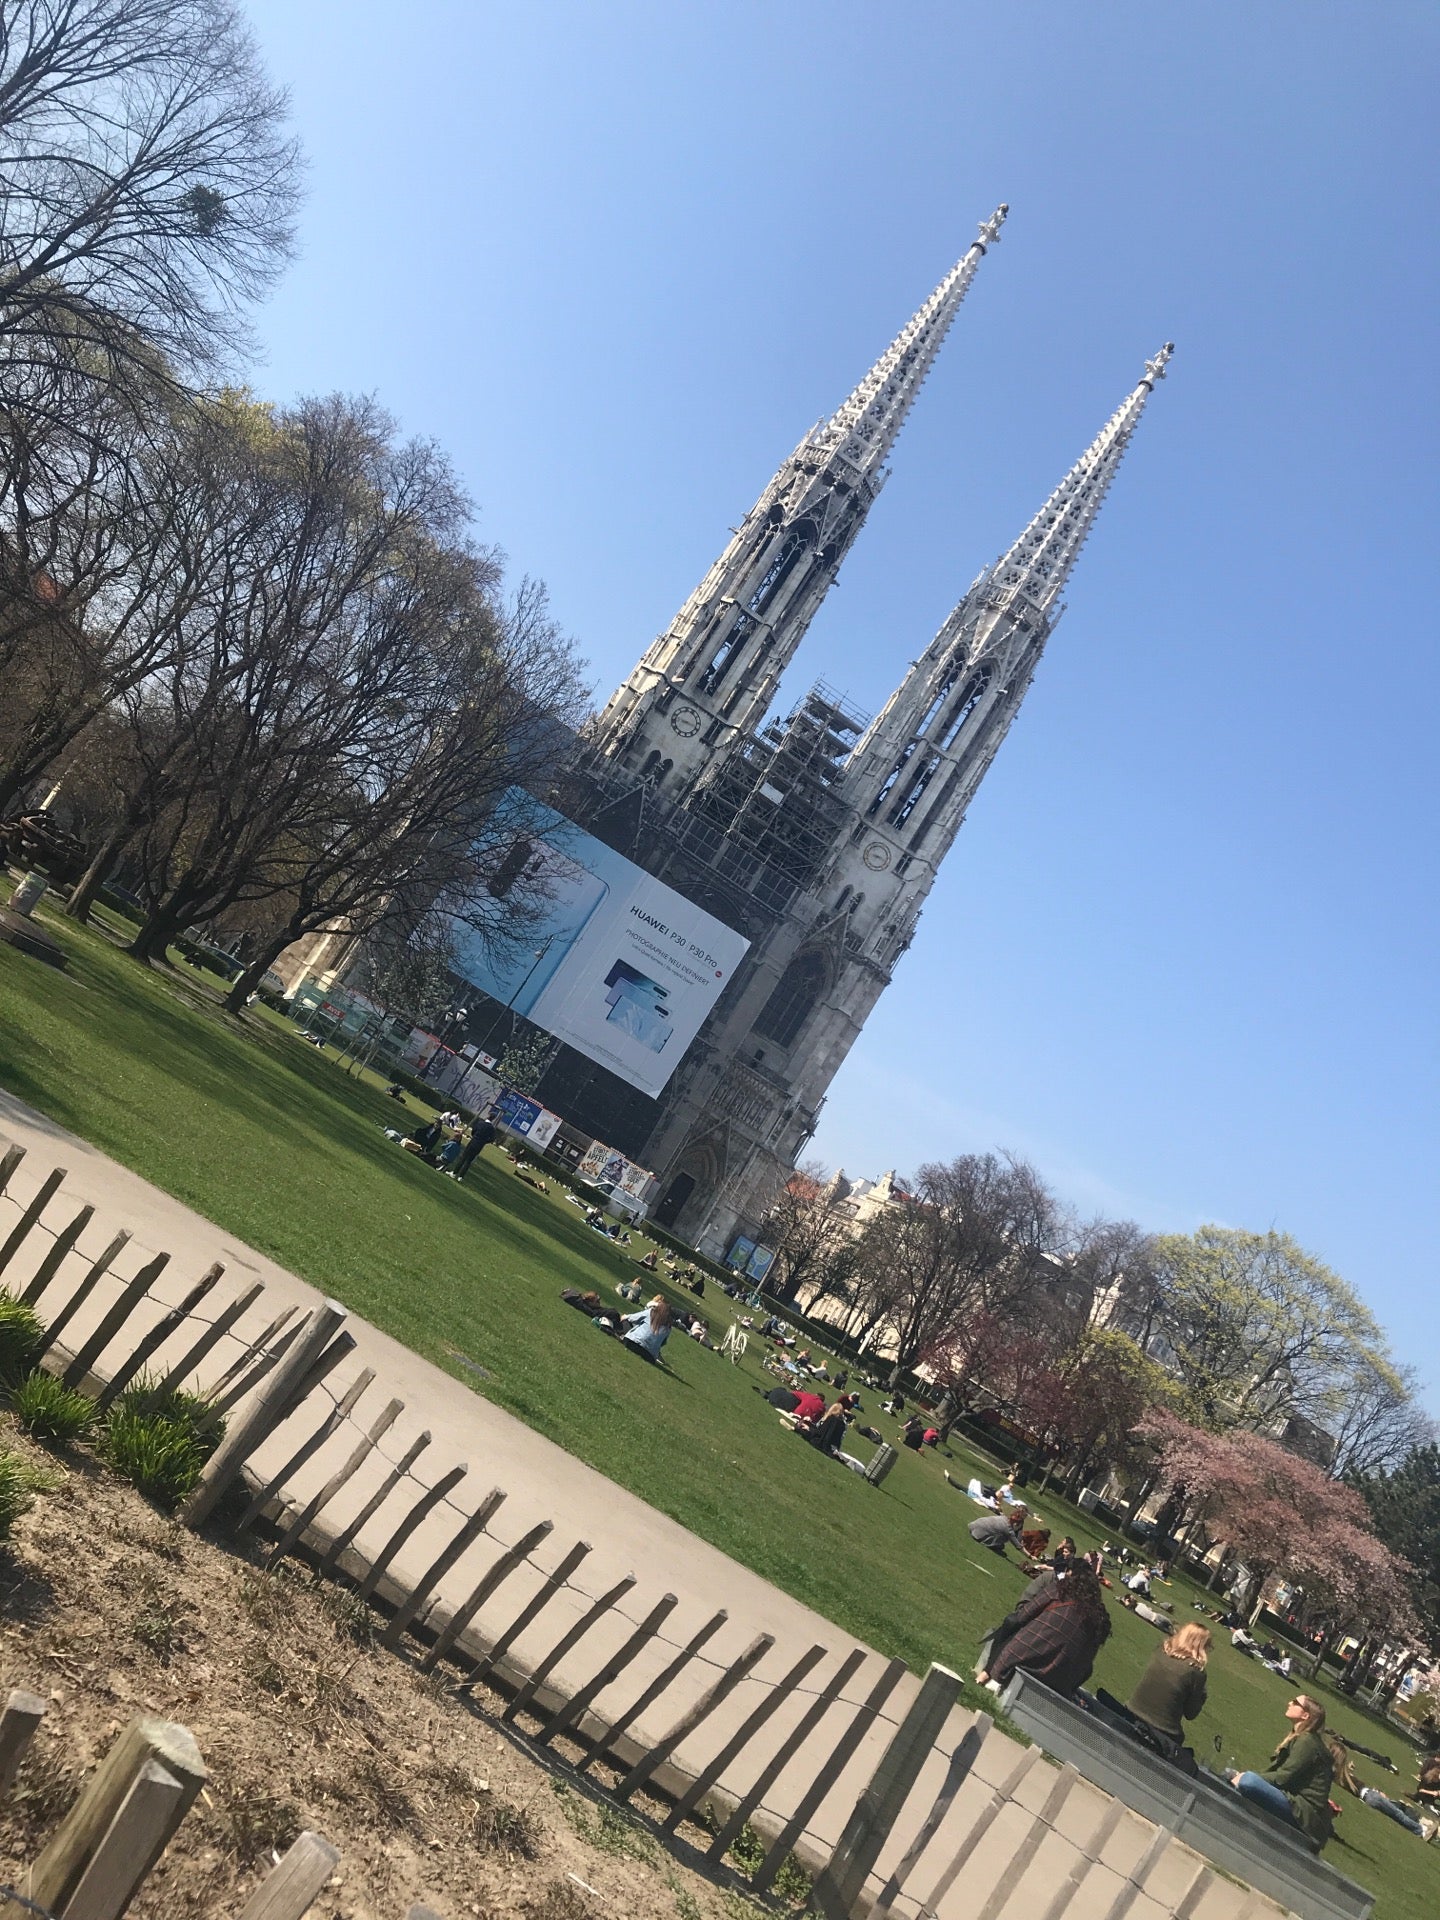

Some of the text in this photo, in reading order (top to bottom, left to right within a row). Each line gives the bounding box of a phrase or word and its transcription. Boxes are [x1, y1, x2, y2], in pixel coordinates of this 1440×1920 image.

[625, 928, 669, 959] PHOTOGRAPHIE
[668, 956, 682, 969] NEU
[681, 964, 710, 986] DEFINIERT
[630, 905, 718, 968] HUAWEI P30 P30 Pro
